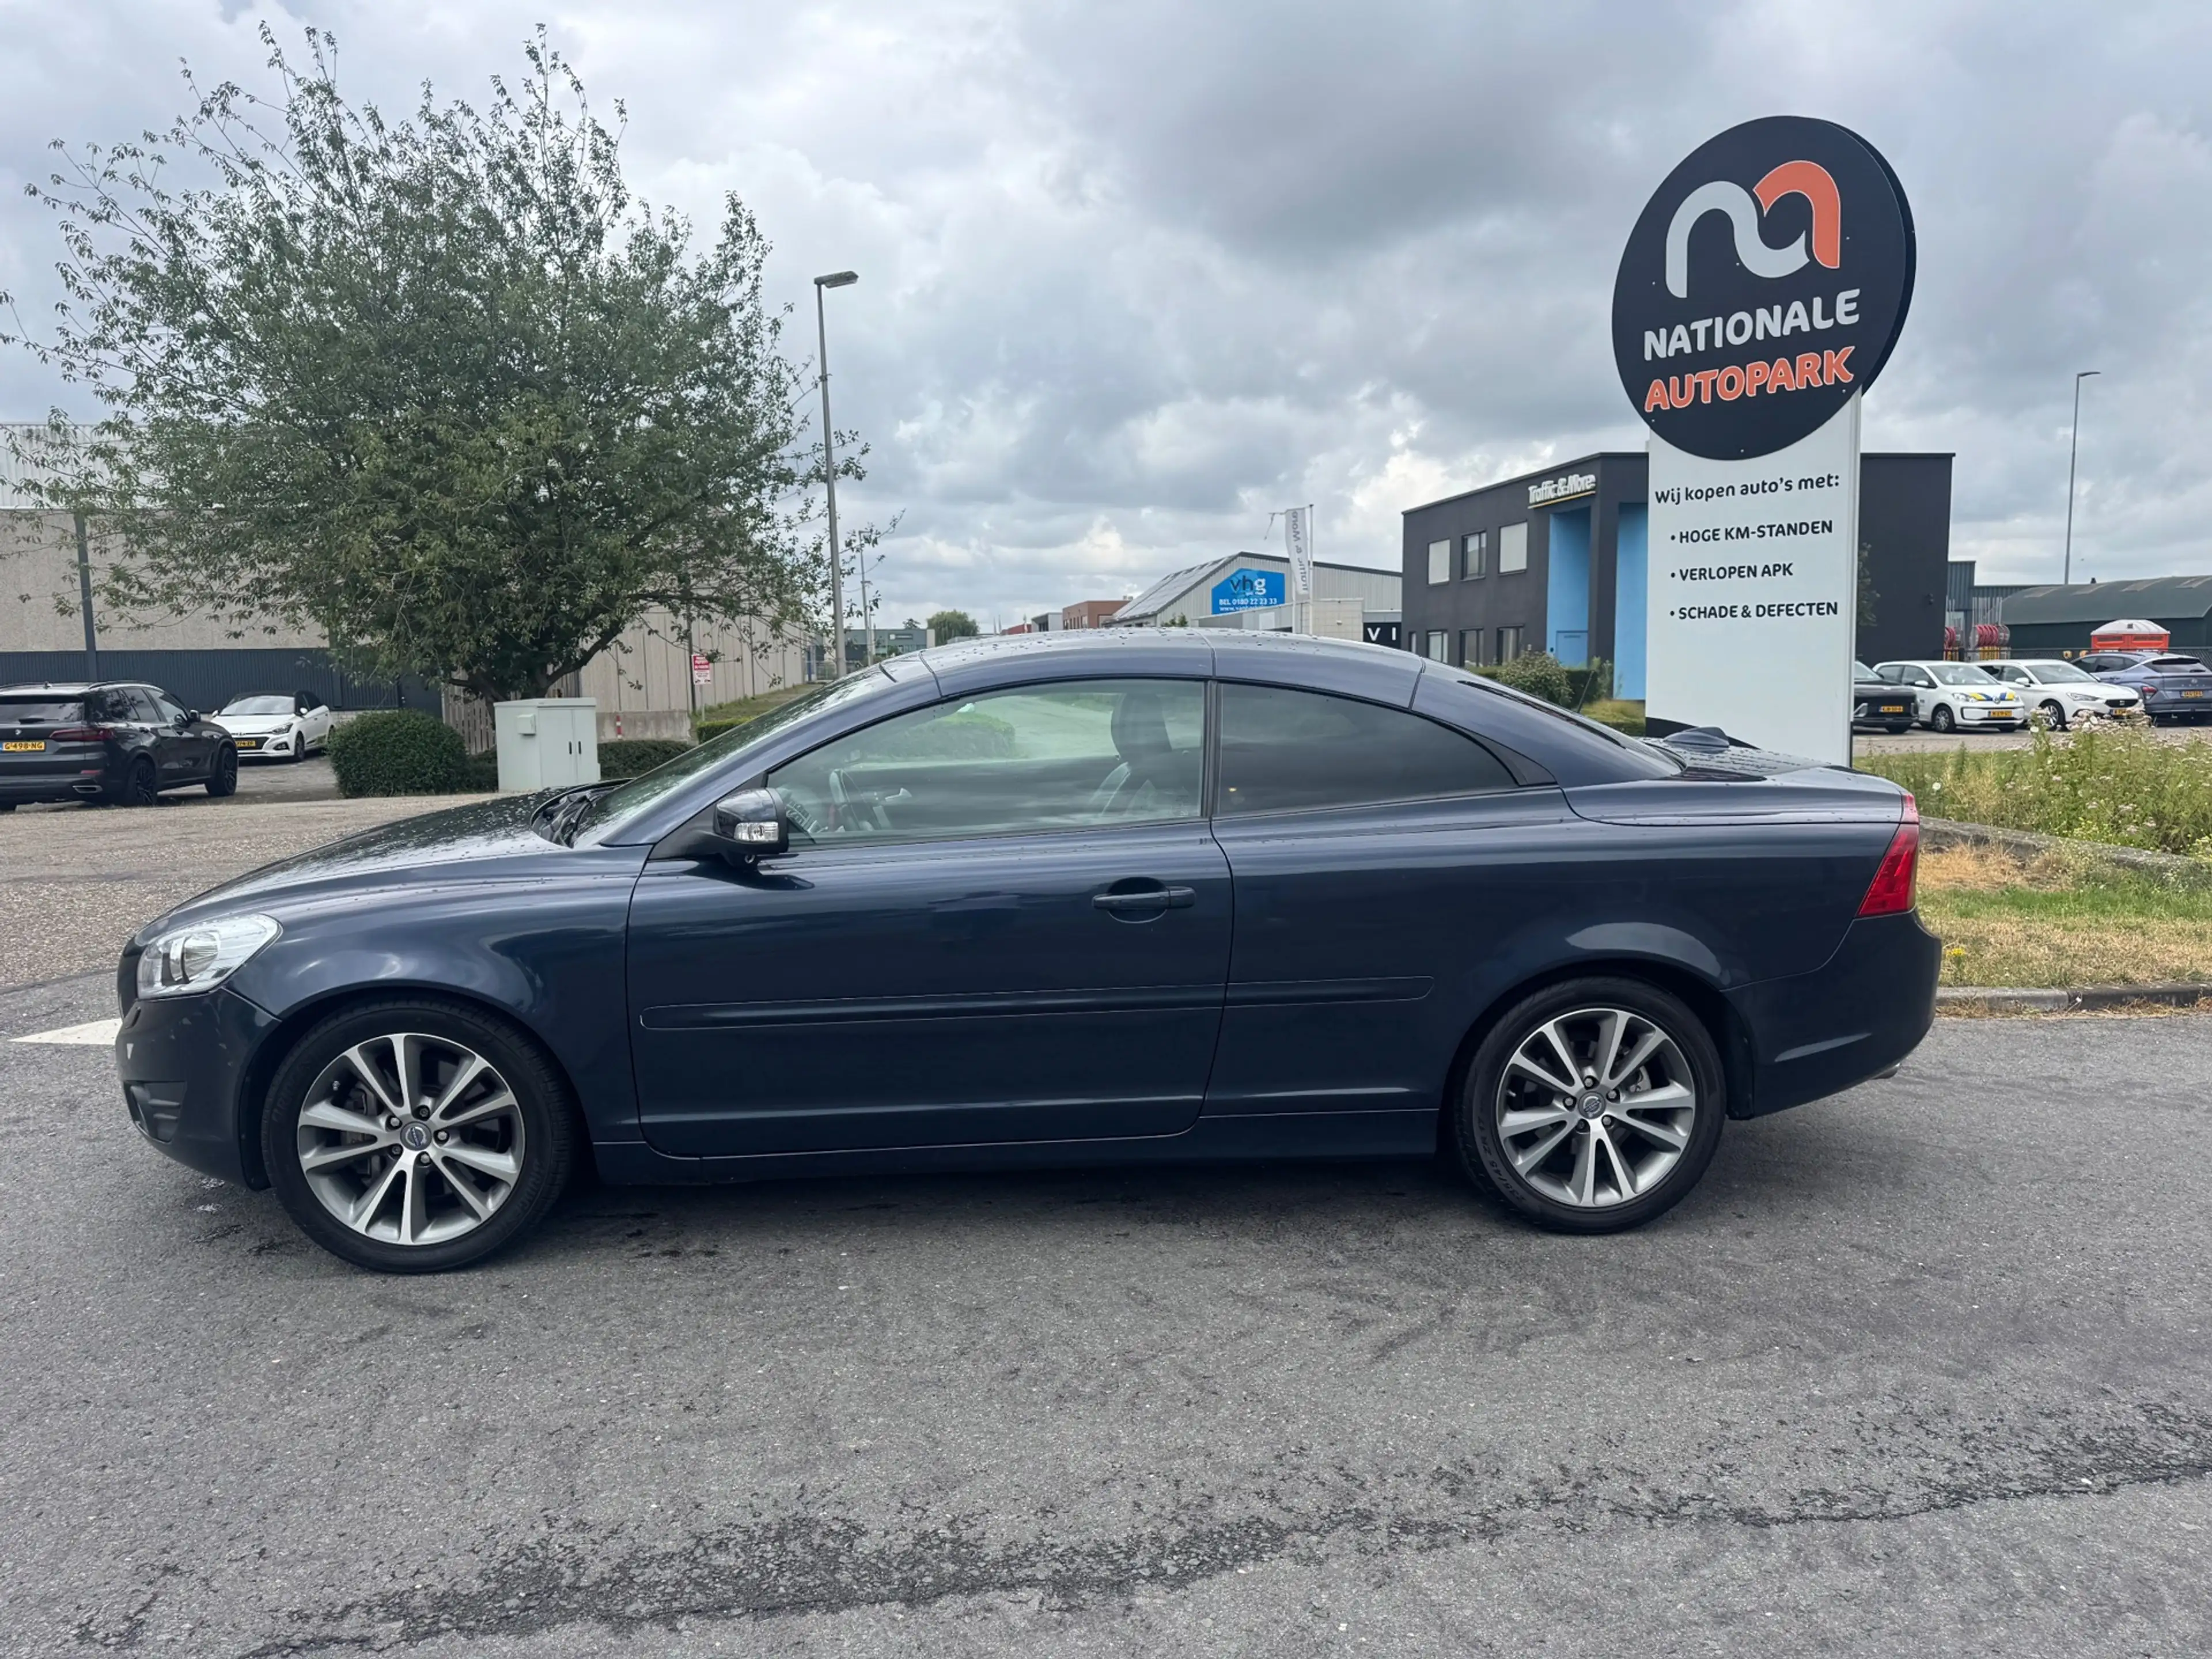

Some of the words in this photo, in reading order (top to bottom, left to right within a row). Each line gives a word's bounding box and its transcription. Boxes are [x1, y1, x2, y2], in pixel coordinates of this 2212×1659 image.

[1645, 289, 1860, 361] NATIONALE
[1645, 346, 1855, 412] AUTOPARK
[1656, 488, 1680, 505] Wij
[1685, 484, 1734, 501] kopen
[1798, 474, 1839, 490] met:
[1680, 529, 1721, 543] HOGE
[1725, 520, 1832, 540] KM-STANDEN
[1680, 566, 1757, 581] VERLOPEN
[1762, 563, 1793, 577] APK
[1230, 574, 1266, 595] vhg
[1679, 605, 1738, 619] SCHADE
[1741, 605, 1752, 618] &
[1756, 602, 1838, 618] DEFECTEN
